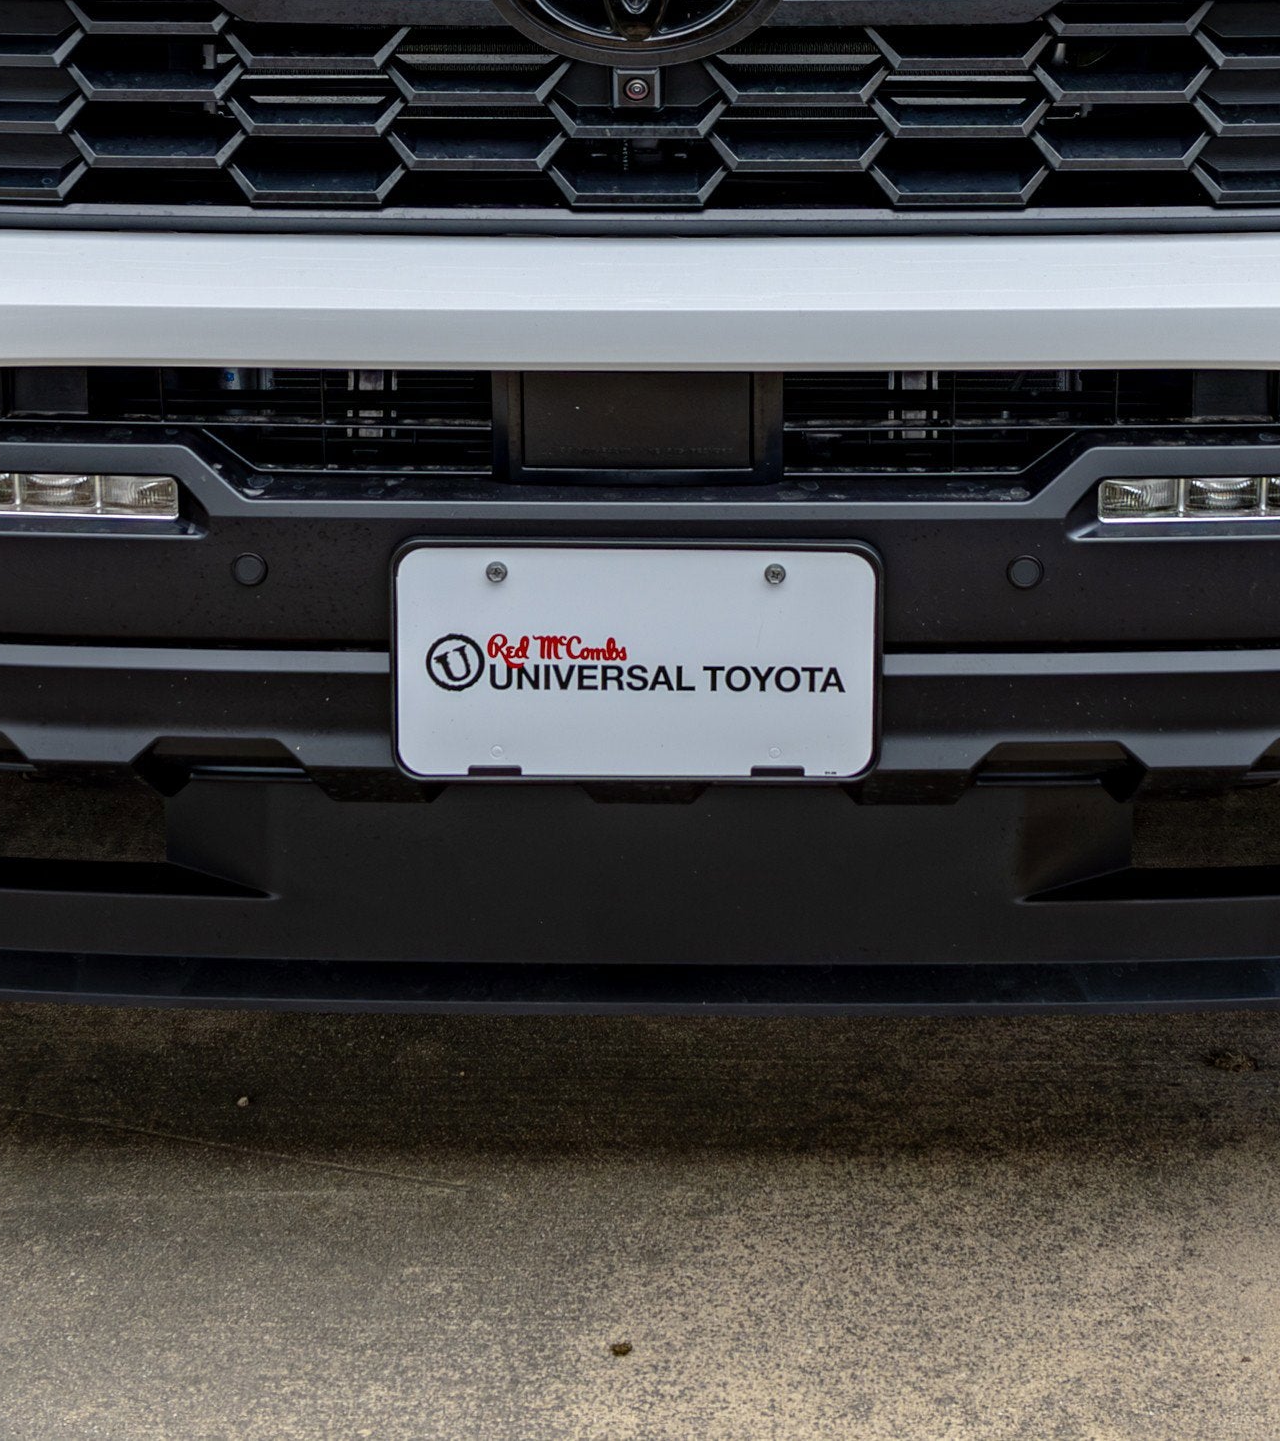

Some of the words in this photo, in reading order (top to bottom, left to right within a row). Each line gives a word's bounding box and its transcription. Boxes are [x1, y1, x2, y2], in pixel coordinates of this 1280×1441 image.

[487, 633, 530, 669] Red
[533, 635, 627, 661] McCombs
[489, 664, 696, 692] UNIVERSAL
[703, 666, 846, 693] TOYOTA
